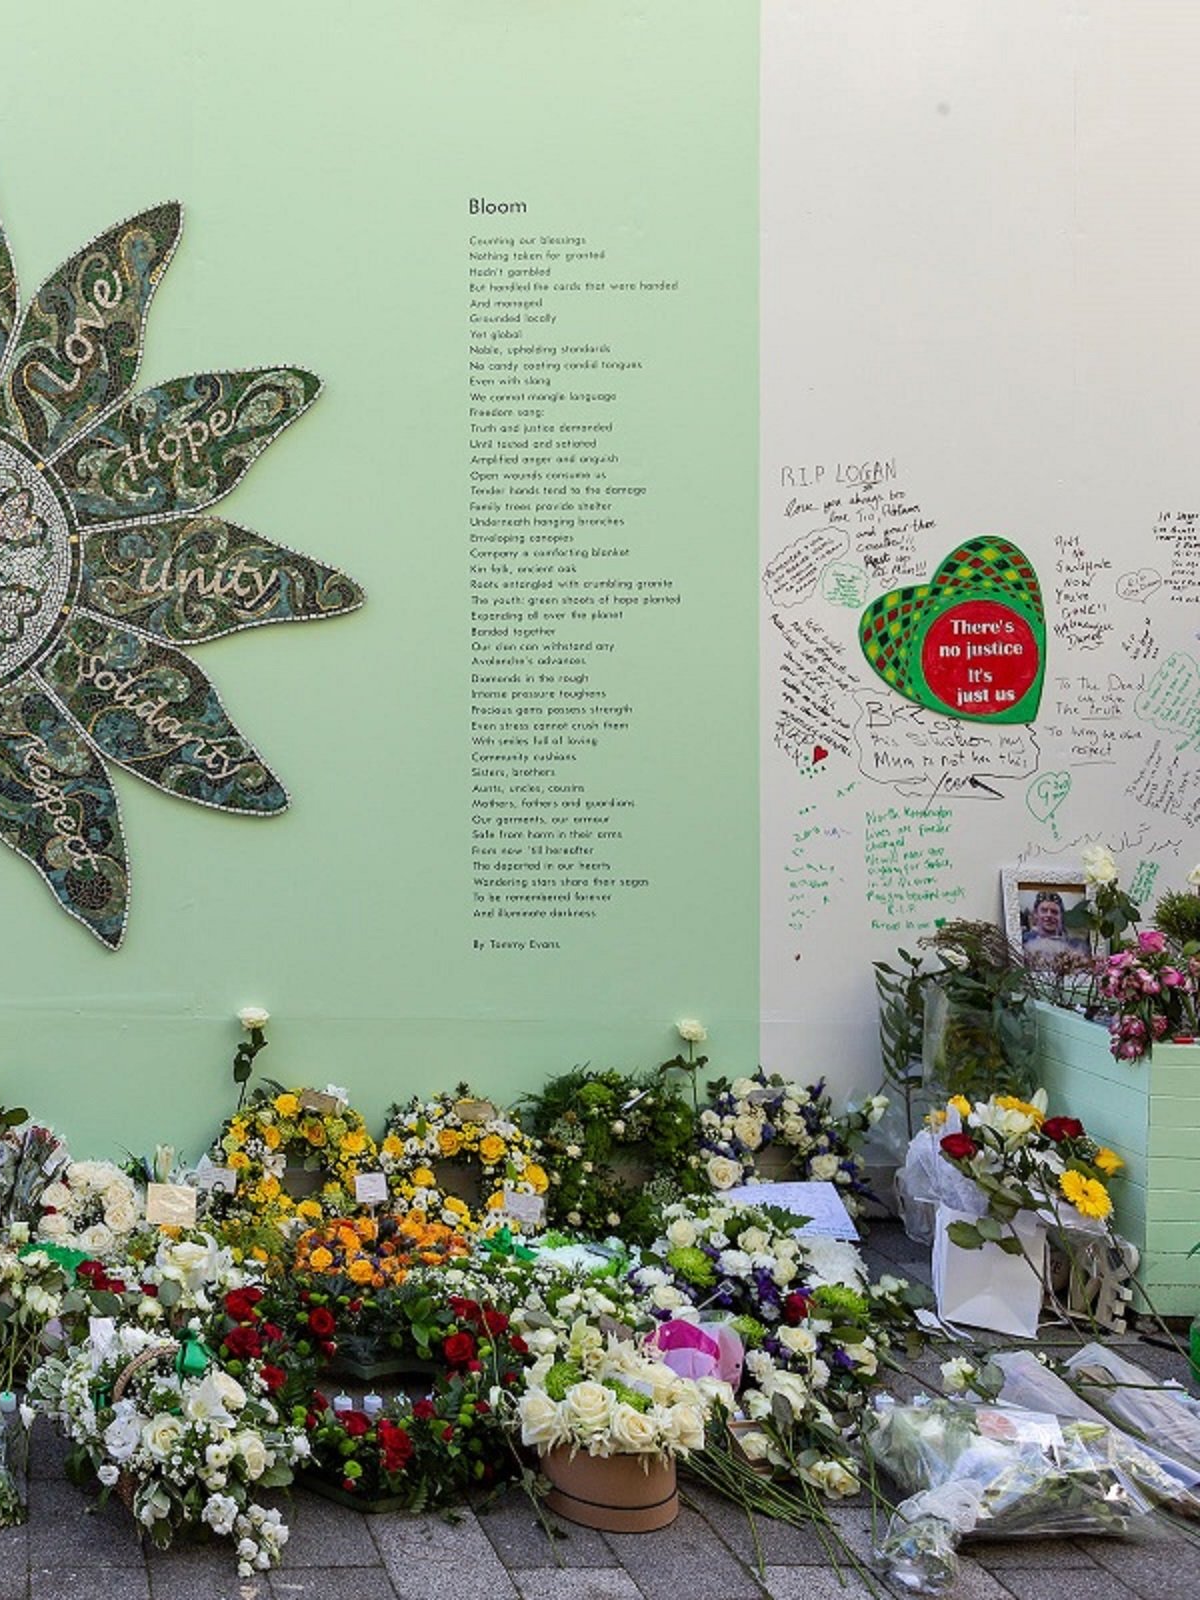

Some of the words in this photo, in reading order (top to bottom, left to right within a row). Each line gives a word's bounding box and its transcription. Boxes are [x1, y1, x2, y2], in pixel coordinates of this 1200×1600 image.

[469, 197, 528, 214] Bloom
[40, 270, 123, 390] Love
[116, 406, 238, 482] Hope
[836, 458, 897, 484] LOGAN
[138, 556, 280, 604] Unity
[950, 619, 1015, 635] There's
[939, 645, 961, 657] no
[966, 641, 1024, 660] justice
[968, 668, 993, 683] It's
[957, 687, 989, 707] just
[995, 689, 1016, 702] us
[78, 655, 244, 780] Solidarity
[16, 740, 100, 872] Respect
